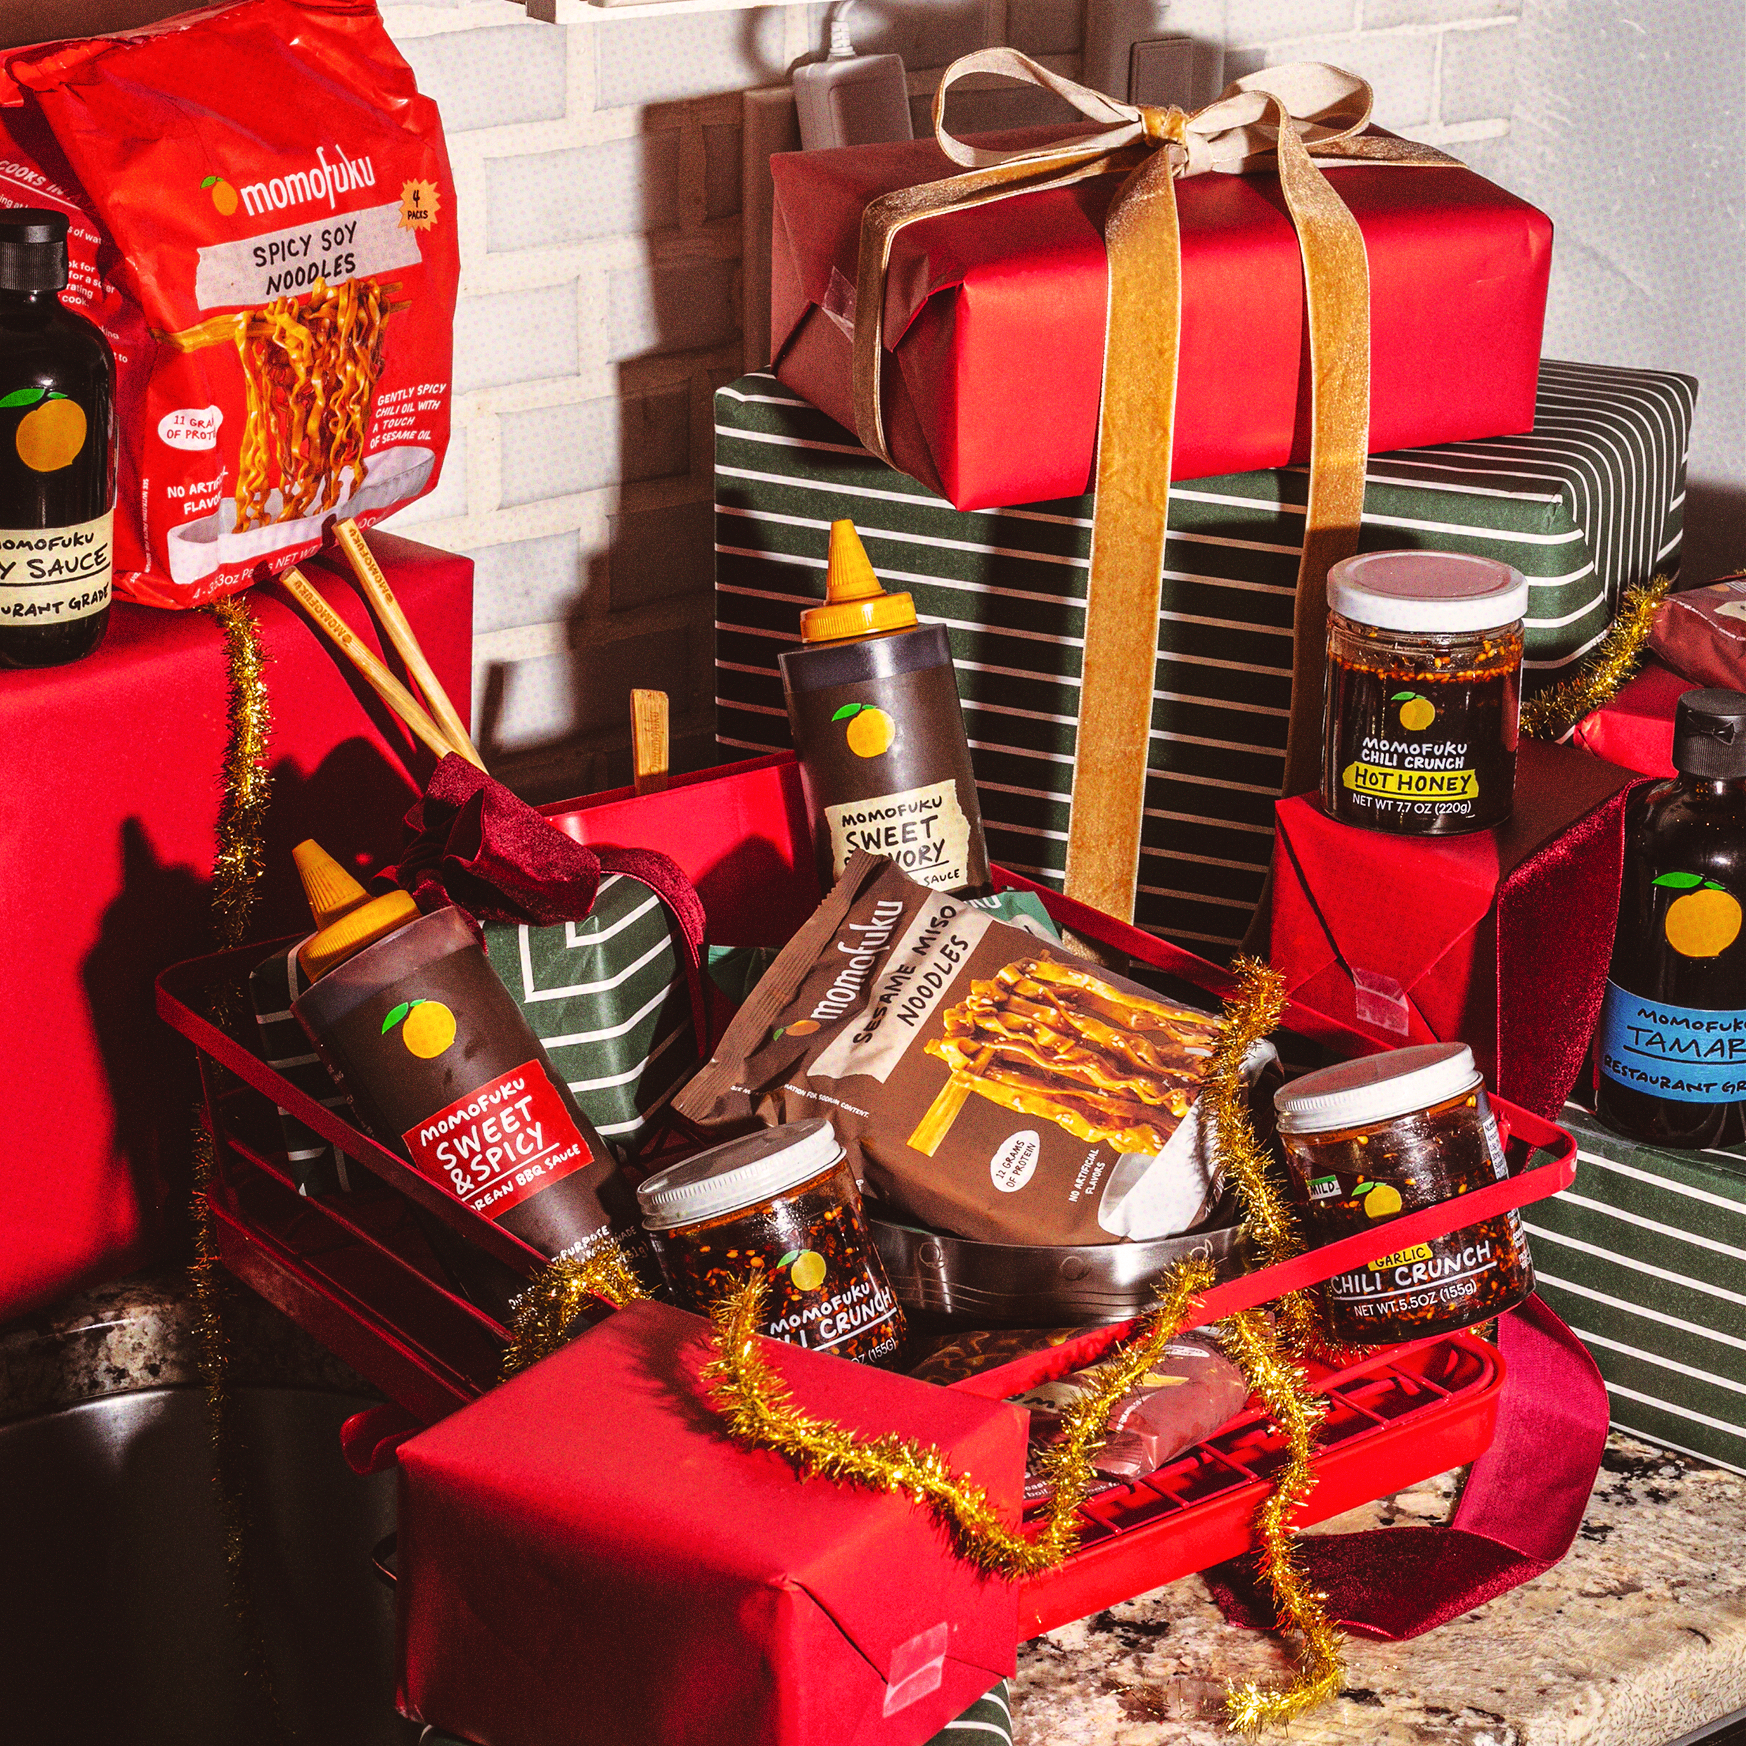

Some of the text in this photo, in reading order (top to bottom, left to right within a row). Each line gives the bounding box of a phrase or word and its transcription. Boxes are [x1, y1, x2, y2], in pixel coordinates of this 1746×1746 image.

[241, 144, 376, 216] momofuku
[413, 189, 420, 208] 4
[407, 210, 429, 220] PACKS
[253, 221, 357, 267] SPICY SOY
[80, 262, 96, 273] for
[265, 253, 356, 295] NOODLES
[375, 400, 441, 418] CHILI OIL WITH
[377, 383, 447, 406] GENTLY SPICY
[166, 429, 181, 439] OF
[173, 415, 186, 425] 11
[372, 416, 416, 433] A TOUCH
[369, 430, 432, 450] OF SESAME OIL
[167, 485, 185, 498] NO
[0, 532, 94, 551] OMOFUKU
[26, 542, 108, 579] SAUCE
[274, 552, 299, 570] NET
[68, 582, 109, 611] GRADE
[1361, 749, 1465, 770] CHILI CRUNCH
[1362, 736, 1468, 756] MOMOFUKU
[1355, 766, 1472, 793] HOT HONEY
[841, 796, 943, 827] MOMOFUKU
[1352, 793, 1472, 816] NET WT 7.7 OZ (220g)
[845, 814, 939, 851] SWEET
[923, 868, 960, 886] SAUCE
[810, 900, 903, 1020] momofuku
[853, 905, 957, 1044] SESAME MISO
[896, 934, 969, 1027] NOODLES
[1637, 1008, 1746, 1033] MOMOFUK
[1604, 1054, 1718, 1094] RESTAURANT
[420, 1077, 526, 1147] MOMOFUKU
[436, 1095, 533, 1170] SWEET
[515, 1164, 547, 1187] BBQ
[544, 1143, 581, 1170] SAUCE
[995, 1140, 1025, 1180] 12 GRAMS
[1006, 1142, 1036, 1188] OF PROTEIN
[1068, 1148, 1100, 1203] NO ARTIFICIAL
[1085, 1161, 1106, 1195] FLAVORS
[1310, 1181, 1335, 1196] MILD
[1330, 1240, 1491, 1294] CHILI CRUNCH
[1374, 1247, 1426, 1268] GARLIC
[770, 1282, 870, 1335] MOMOFUKU
[819, 1286, 893, 1339] CRUNCH
[1354, 1302, 1375, 1317] NET
[1440, 1279, 1478, 1303] (155g)
[868, 1337, 897, 1363] (155G)
